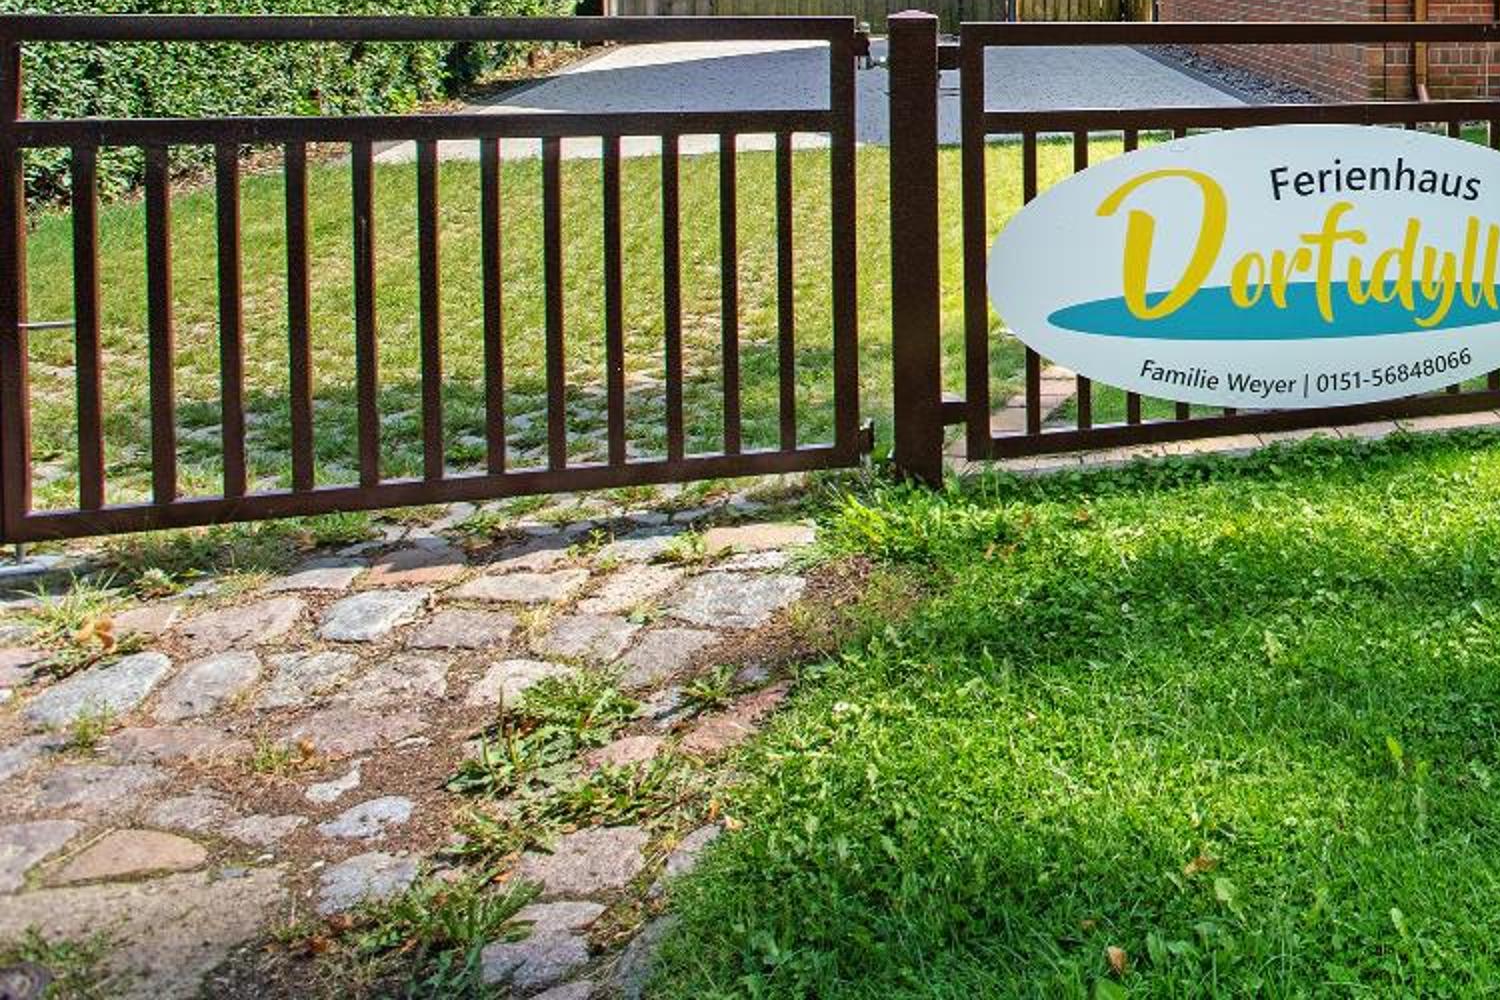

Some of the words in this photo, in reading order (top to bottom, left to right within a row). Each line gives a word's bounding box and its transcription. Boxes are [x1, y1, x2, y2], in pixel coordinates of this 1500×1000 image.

[1269, 157, 1482, 201] Ferienhaus
[1139, 359, 1220, 391] Familie
[1227, 372, 1298, 399] Weyer
[1316, 347, 1473, 393] 0151-56848066
